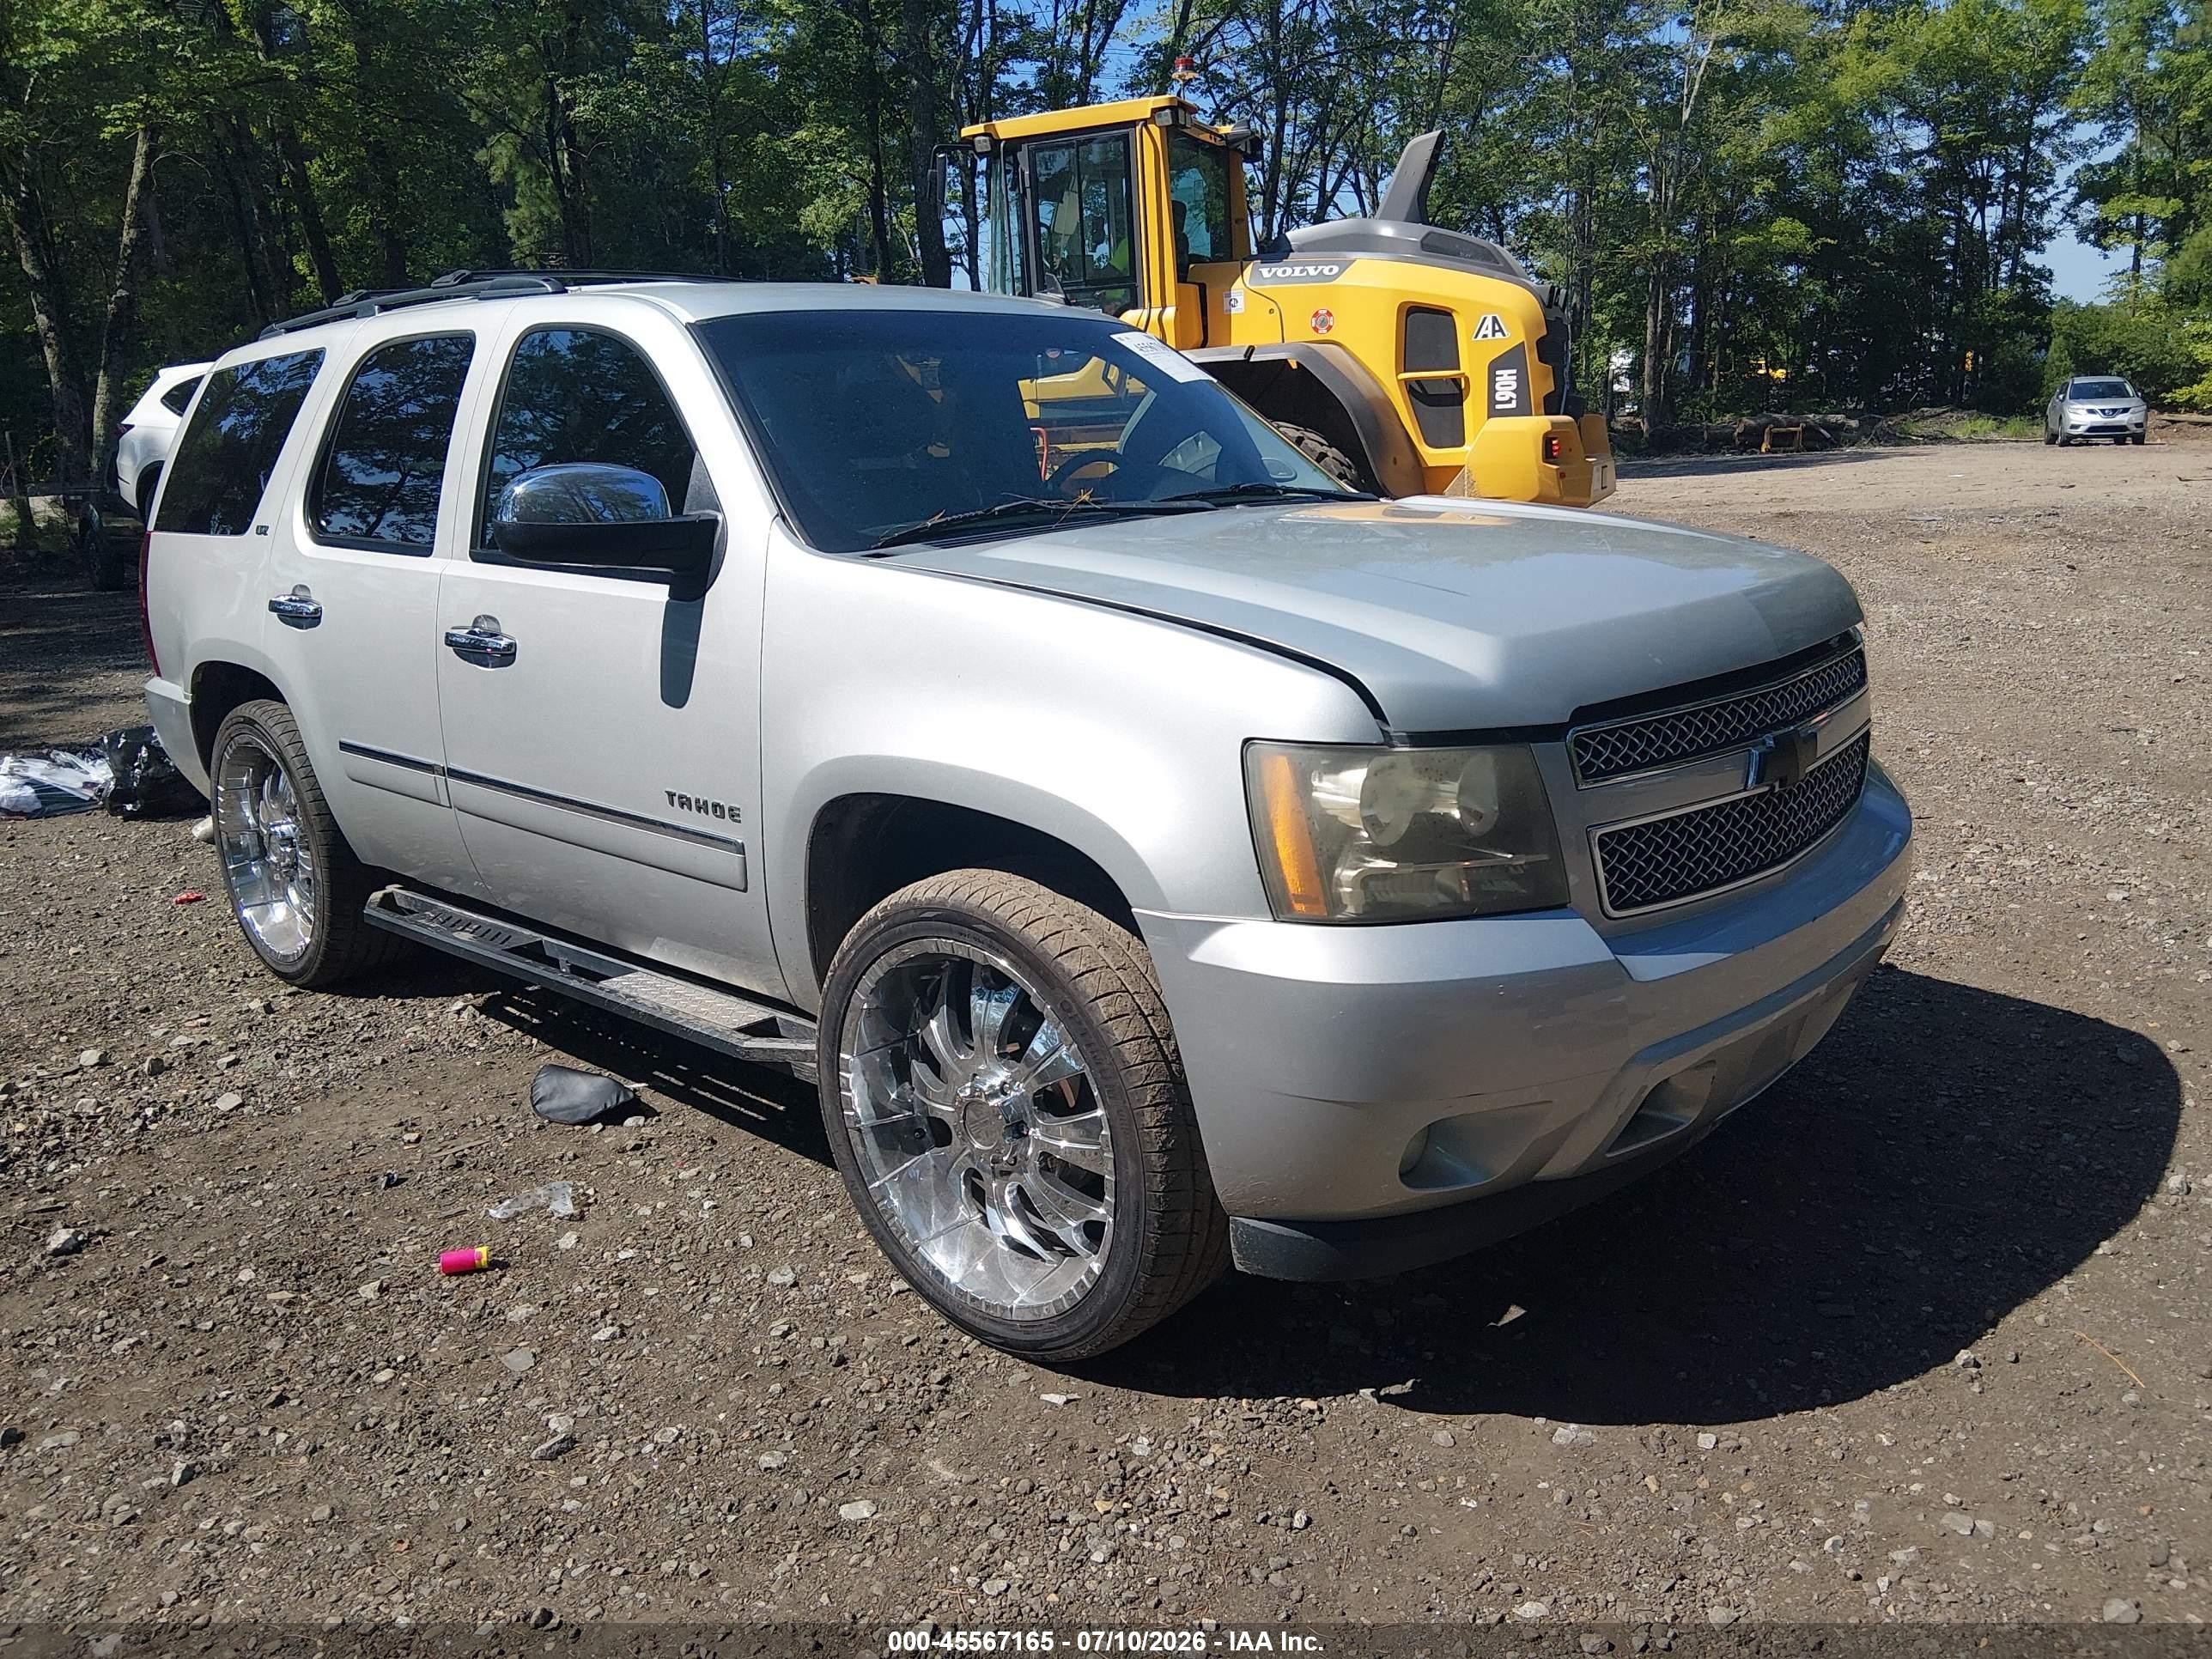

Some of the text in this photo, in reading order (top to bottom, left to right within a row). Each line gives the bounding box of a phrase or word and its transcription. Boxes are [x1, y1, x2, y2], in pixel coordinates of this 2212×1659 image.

[1258, 264, 1340, 278] VOLVO
[1495, 368, 1517, 410] L90H
[665, 790, 742, 823] TAHOE
